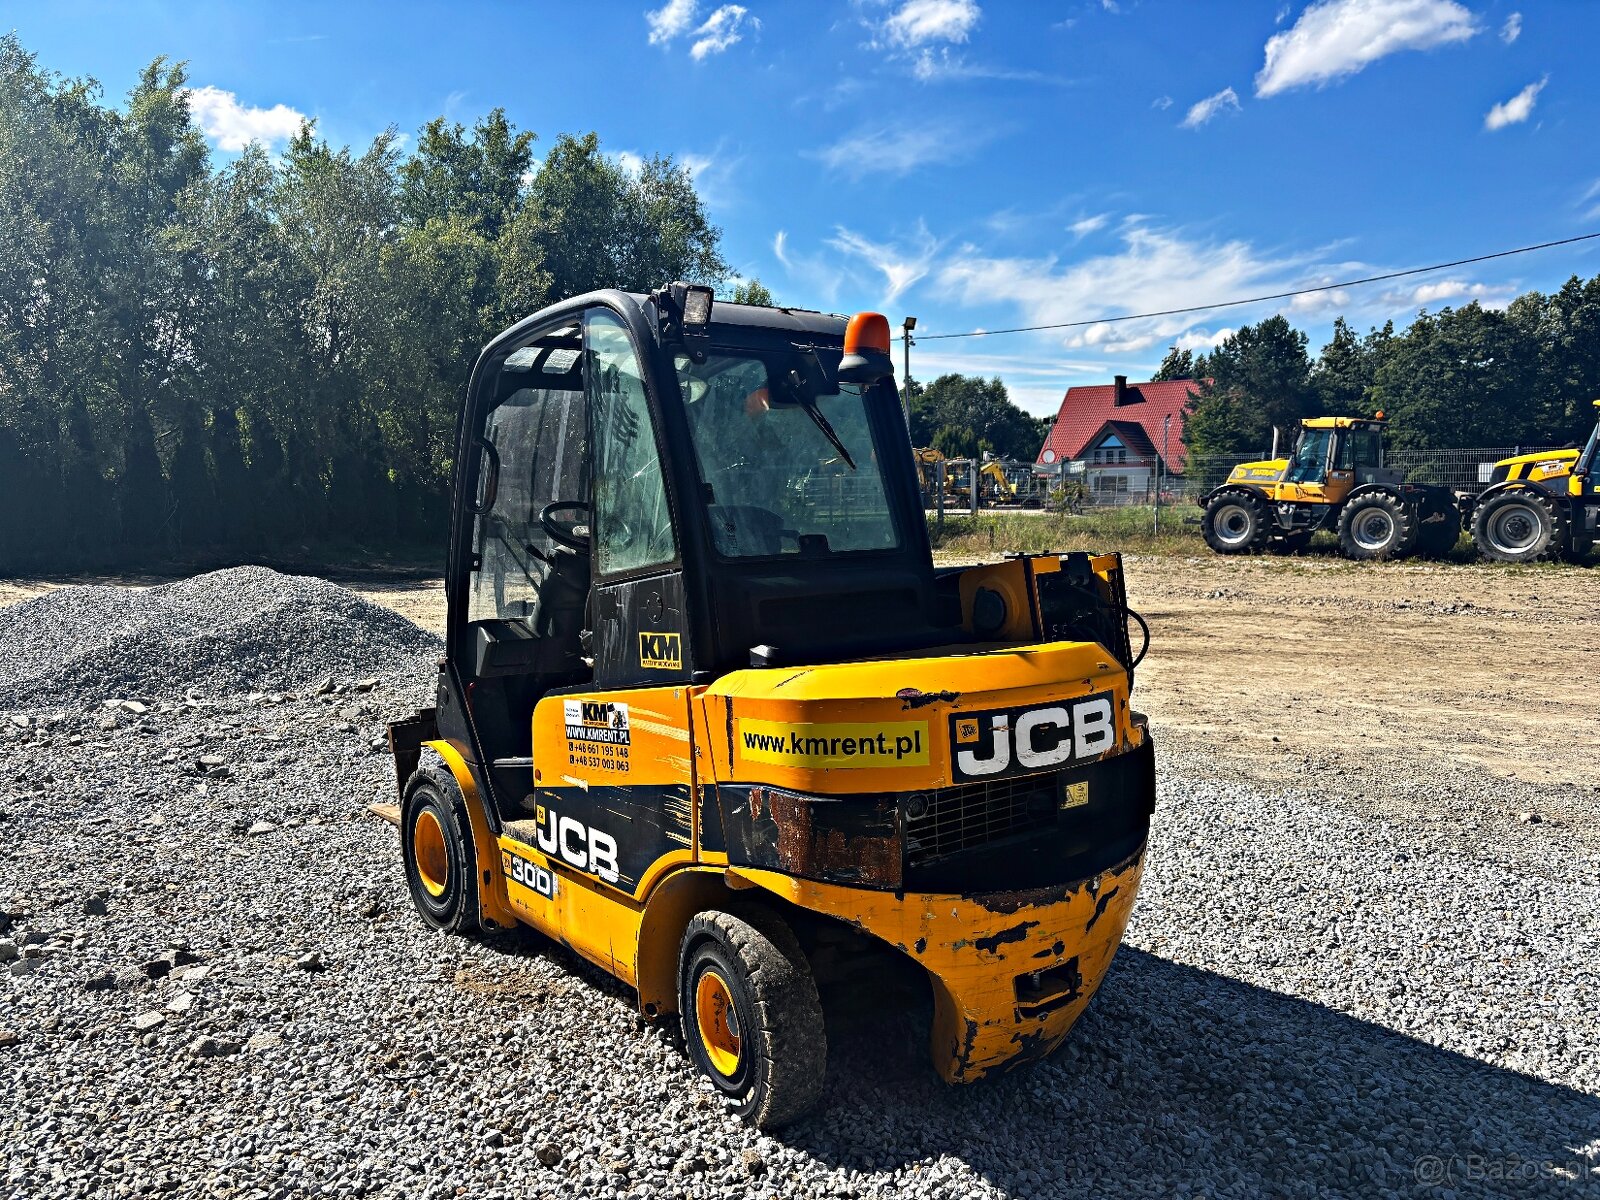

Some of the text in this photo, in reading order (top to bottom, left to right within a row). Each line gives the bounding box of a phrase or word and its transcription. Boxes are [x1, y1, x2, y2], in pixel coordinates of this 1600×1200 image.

[641, 634, 680, 661] KM
[582, 702, 608, 722] KM
[565, 725, 630, 744] WWW.KMRENT.PL
[743, 730, 921, 760] www.kmrent.pl
[957, 698, 1114, 776] JCB
[574, 742, 629, 759] +48 661 195 148
[575, 755, 630, 772] +48 537 003 063
[537, 809, 620, 884] JCB
[512, 854, 551, 896] 30D
